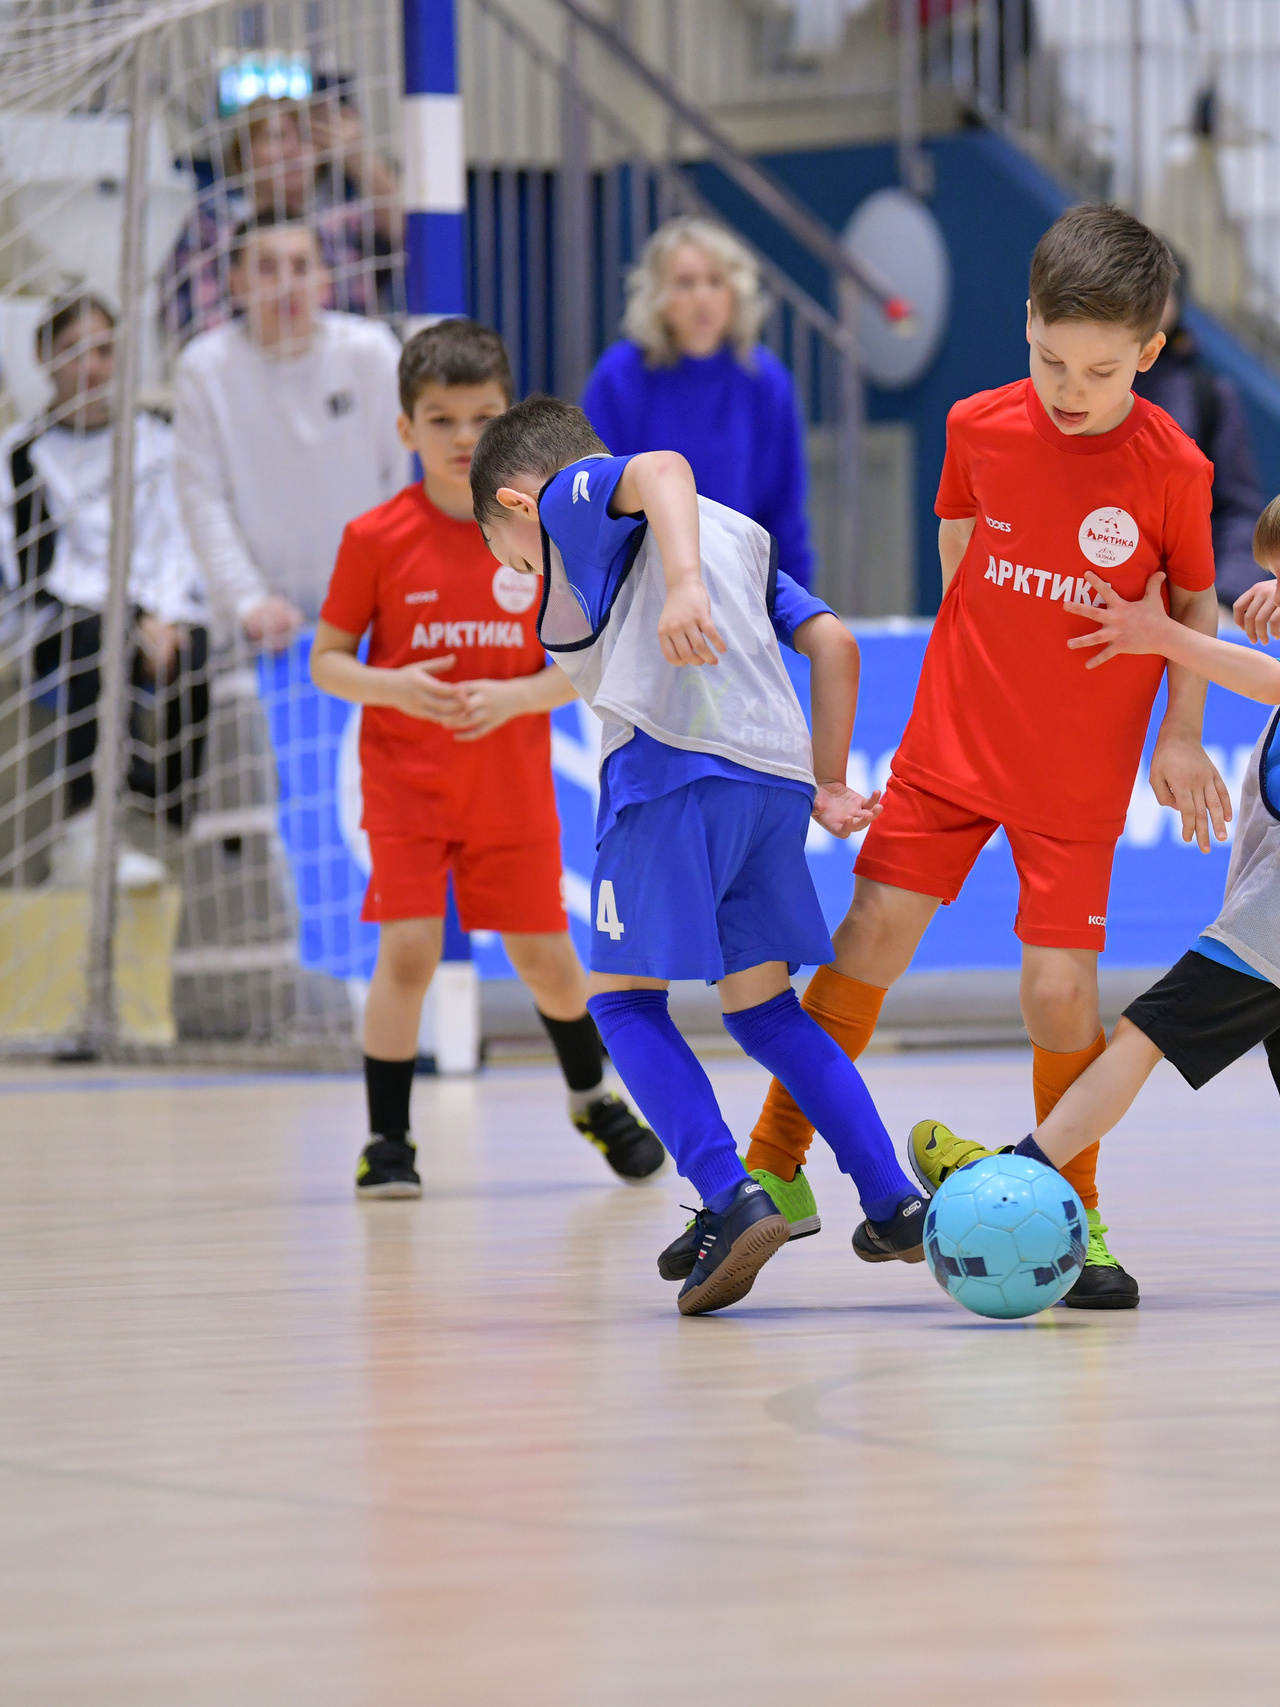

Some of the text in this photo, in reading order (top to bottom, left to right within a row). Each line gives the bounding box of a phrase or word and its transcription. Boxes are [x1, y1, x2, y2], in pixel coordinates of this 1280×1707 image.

[411, 621, 524, 649] АРКТИКА
[596, 879, 625, 941] 4
[902, 1200, 922, 1218] GSD
